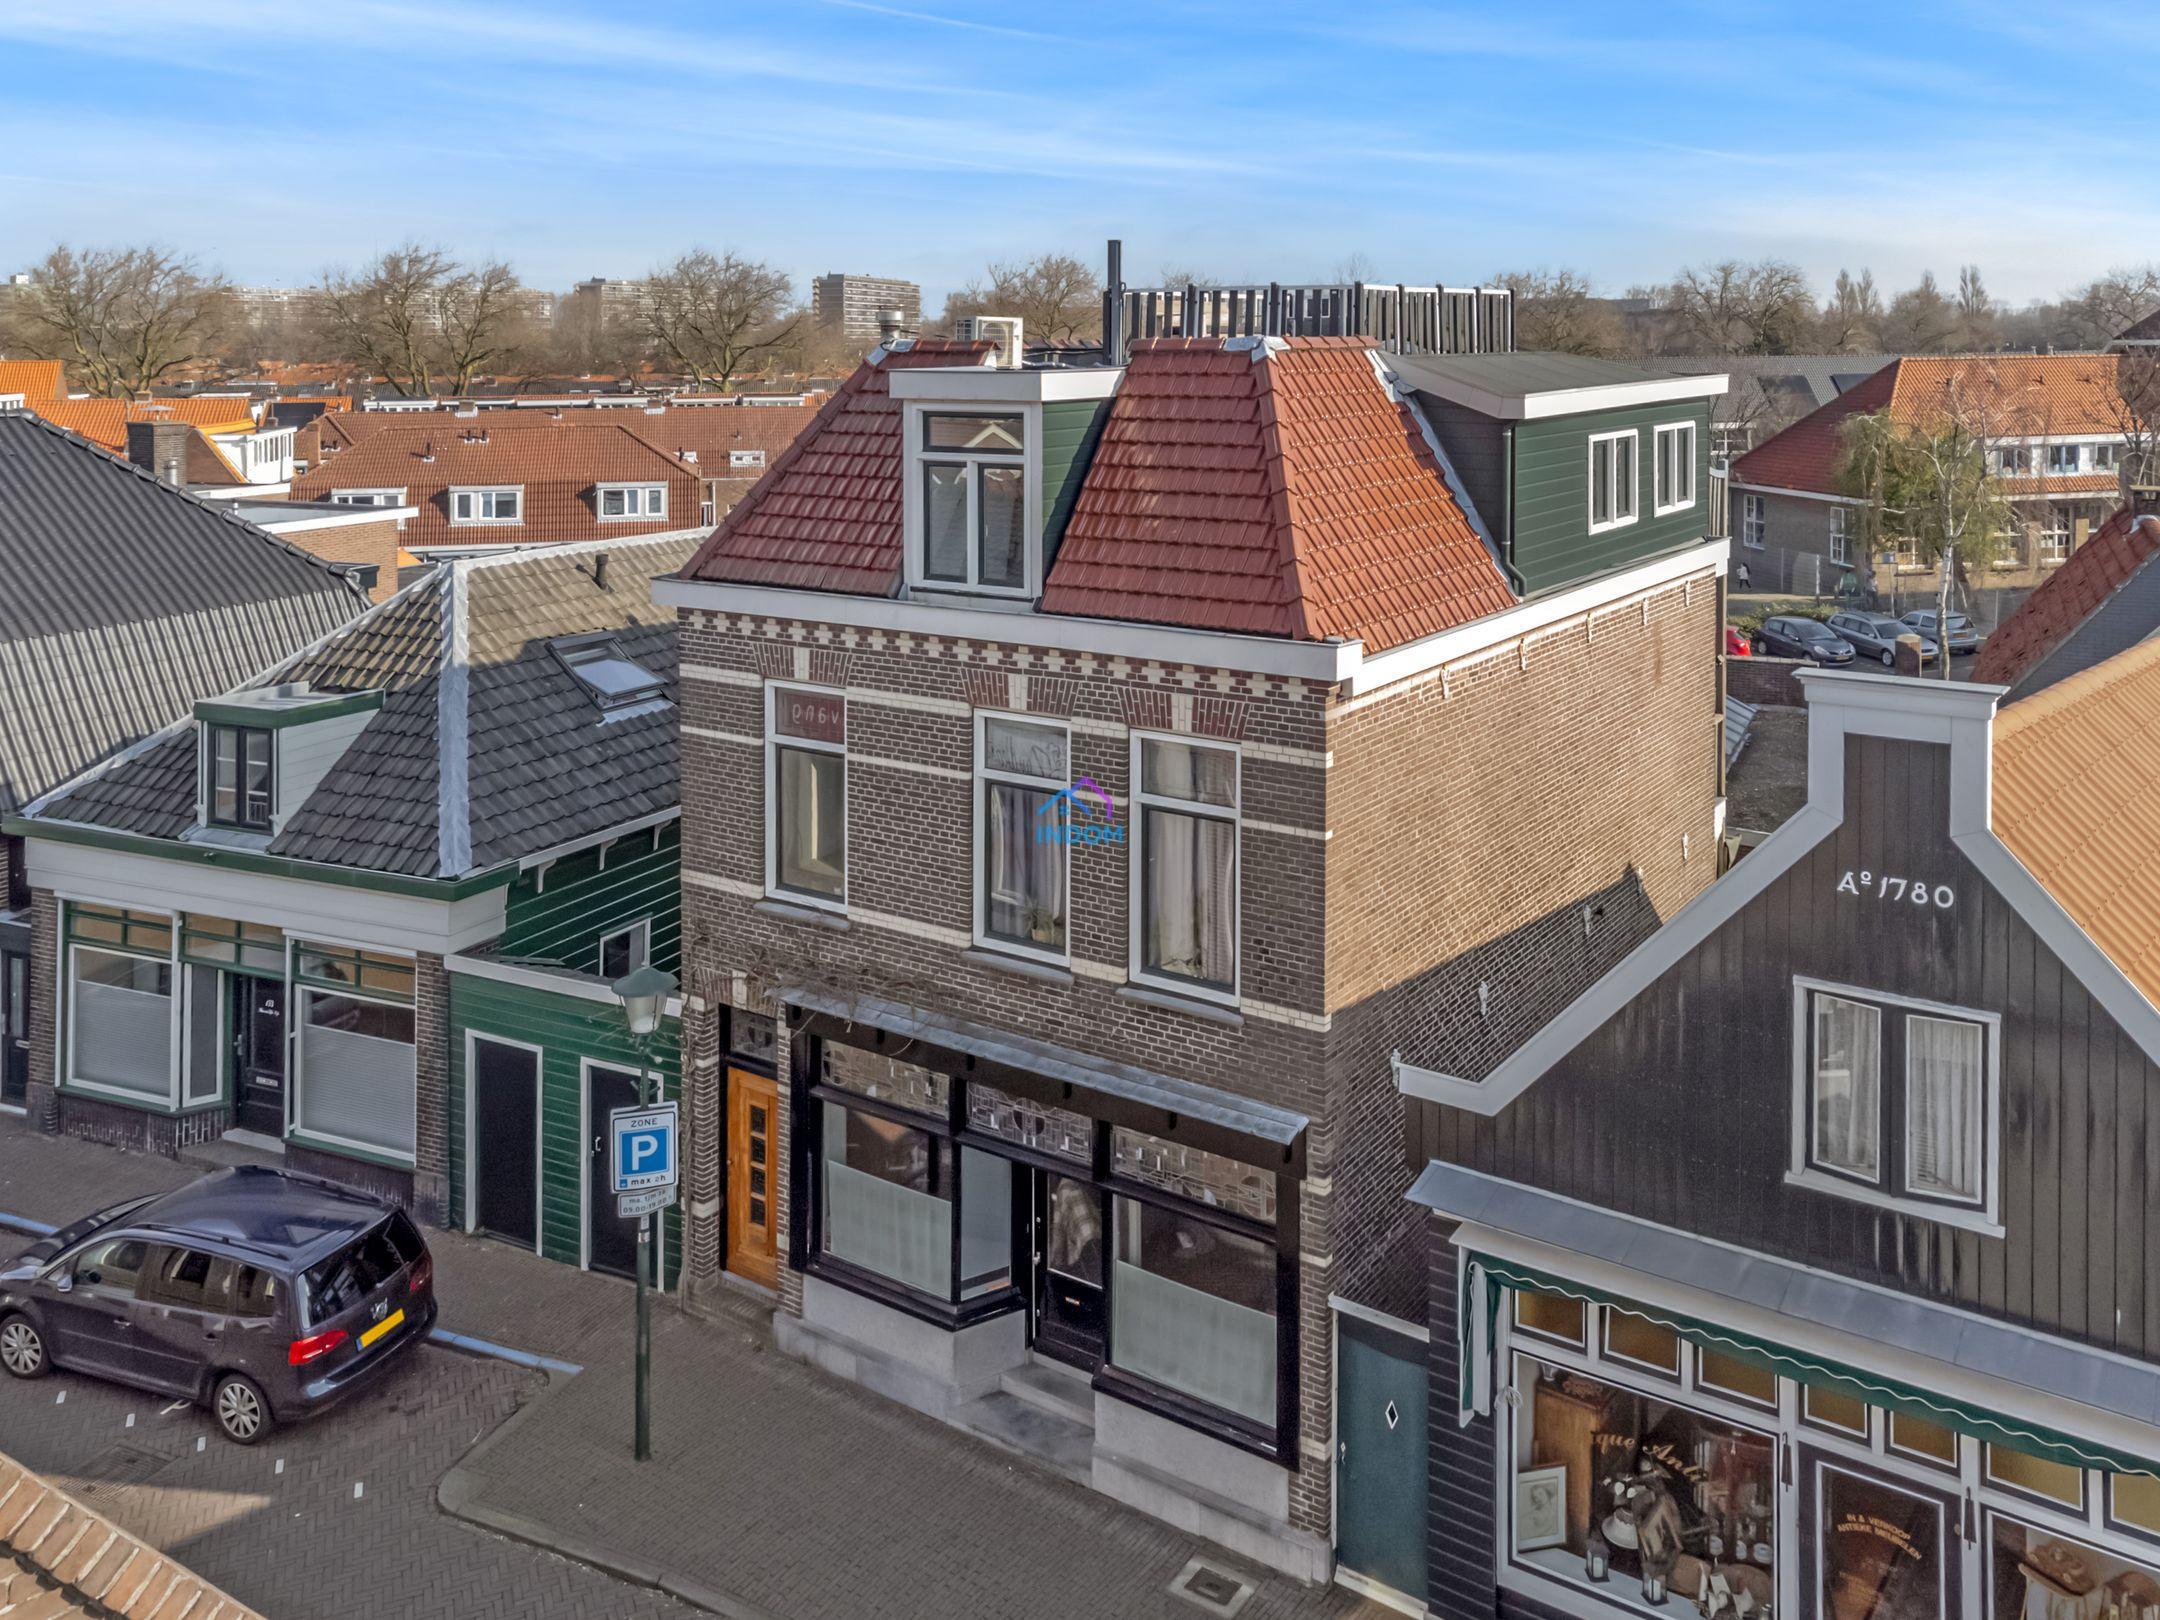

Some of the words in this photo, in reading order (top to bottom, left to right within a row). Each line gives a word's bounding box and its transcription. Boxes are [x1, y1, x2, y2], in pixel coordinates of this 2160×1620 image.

[1877, 876, 1954, 908] 1780
[631, 1118, 658, 1127] ZONE
[632, 1135, 658, 1170] P
